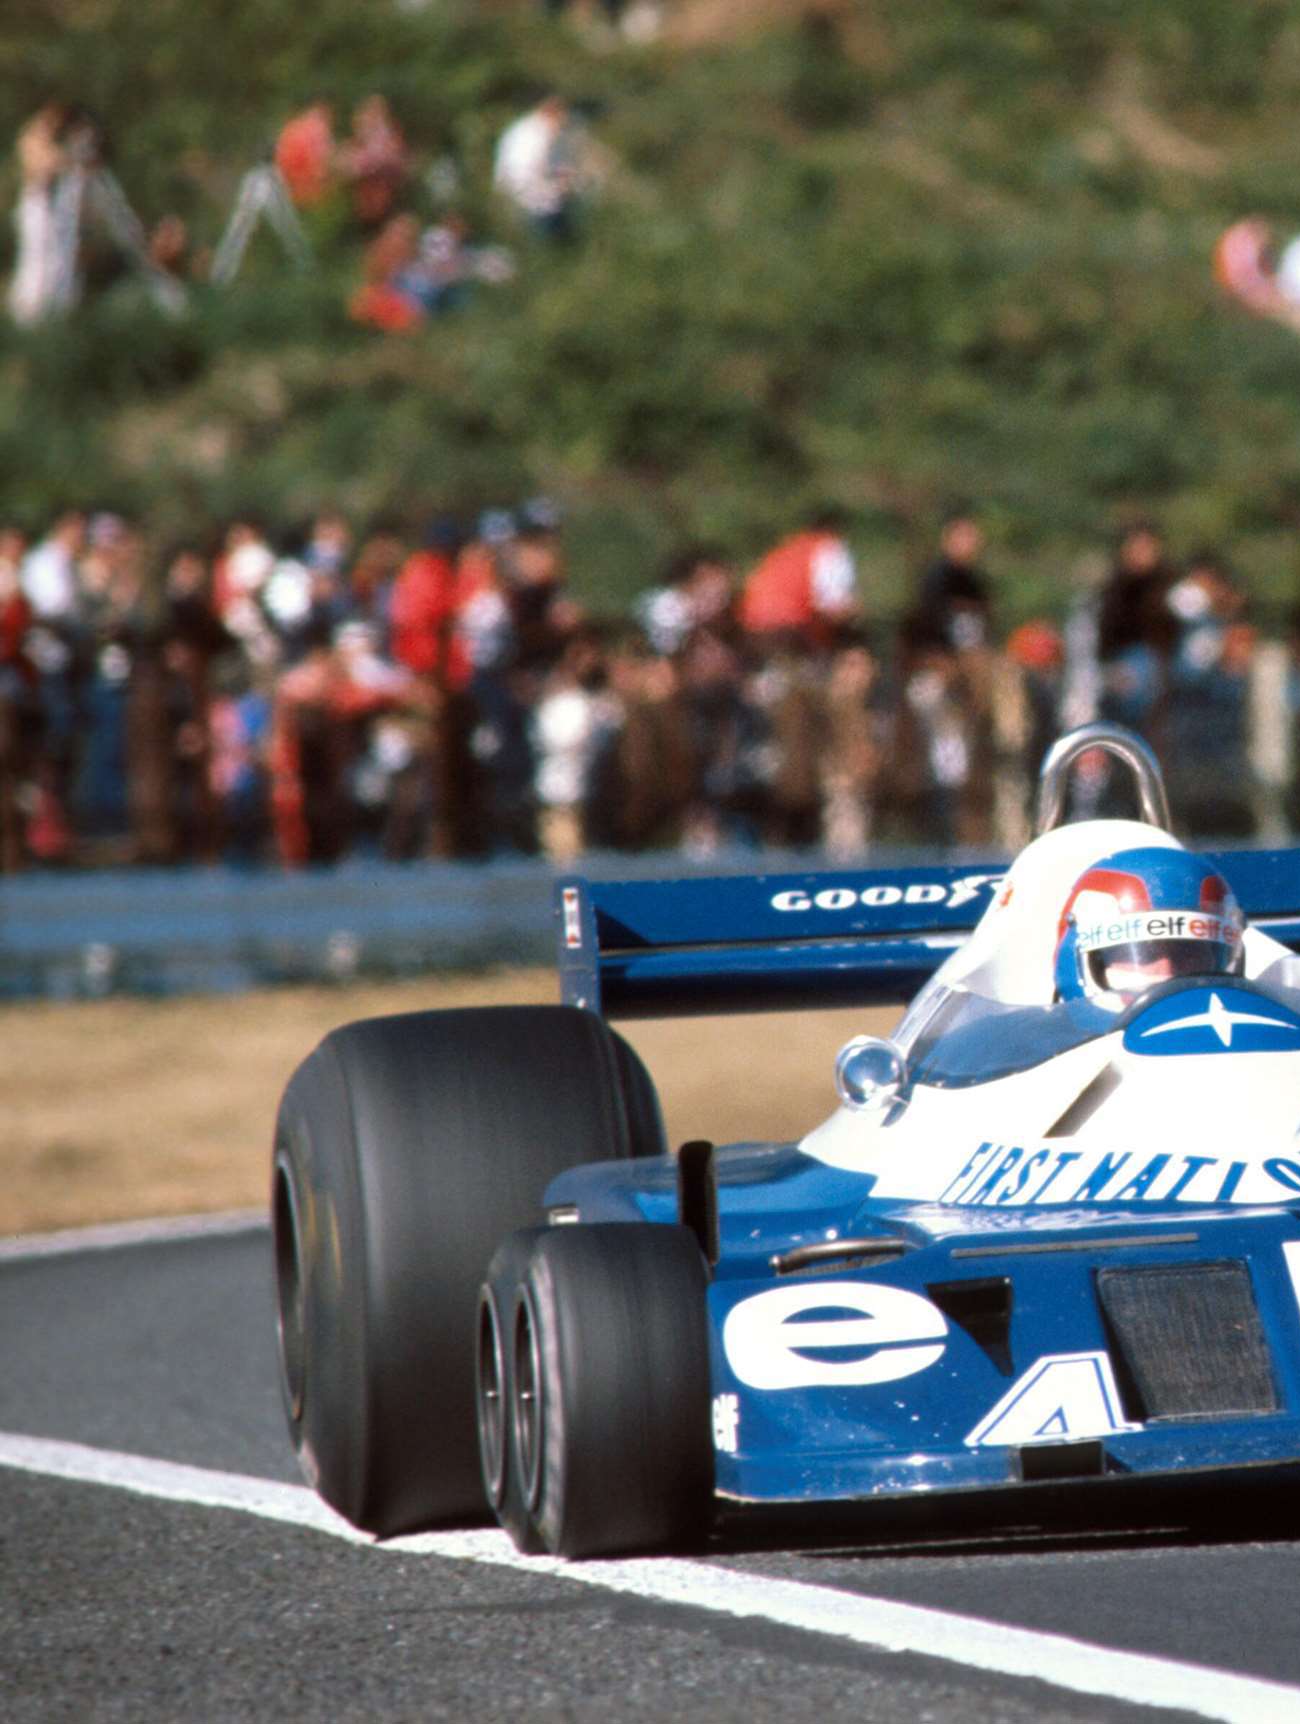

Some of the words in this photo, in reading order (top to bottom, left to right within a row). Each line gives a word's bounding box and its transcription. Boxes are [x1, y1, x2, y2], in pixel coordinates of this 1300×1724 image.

[1107, 918, 1142, 941] elf
[1147, 916, 1187, 936] elf
[937, 1141, 1084, 1205] FIRST
